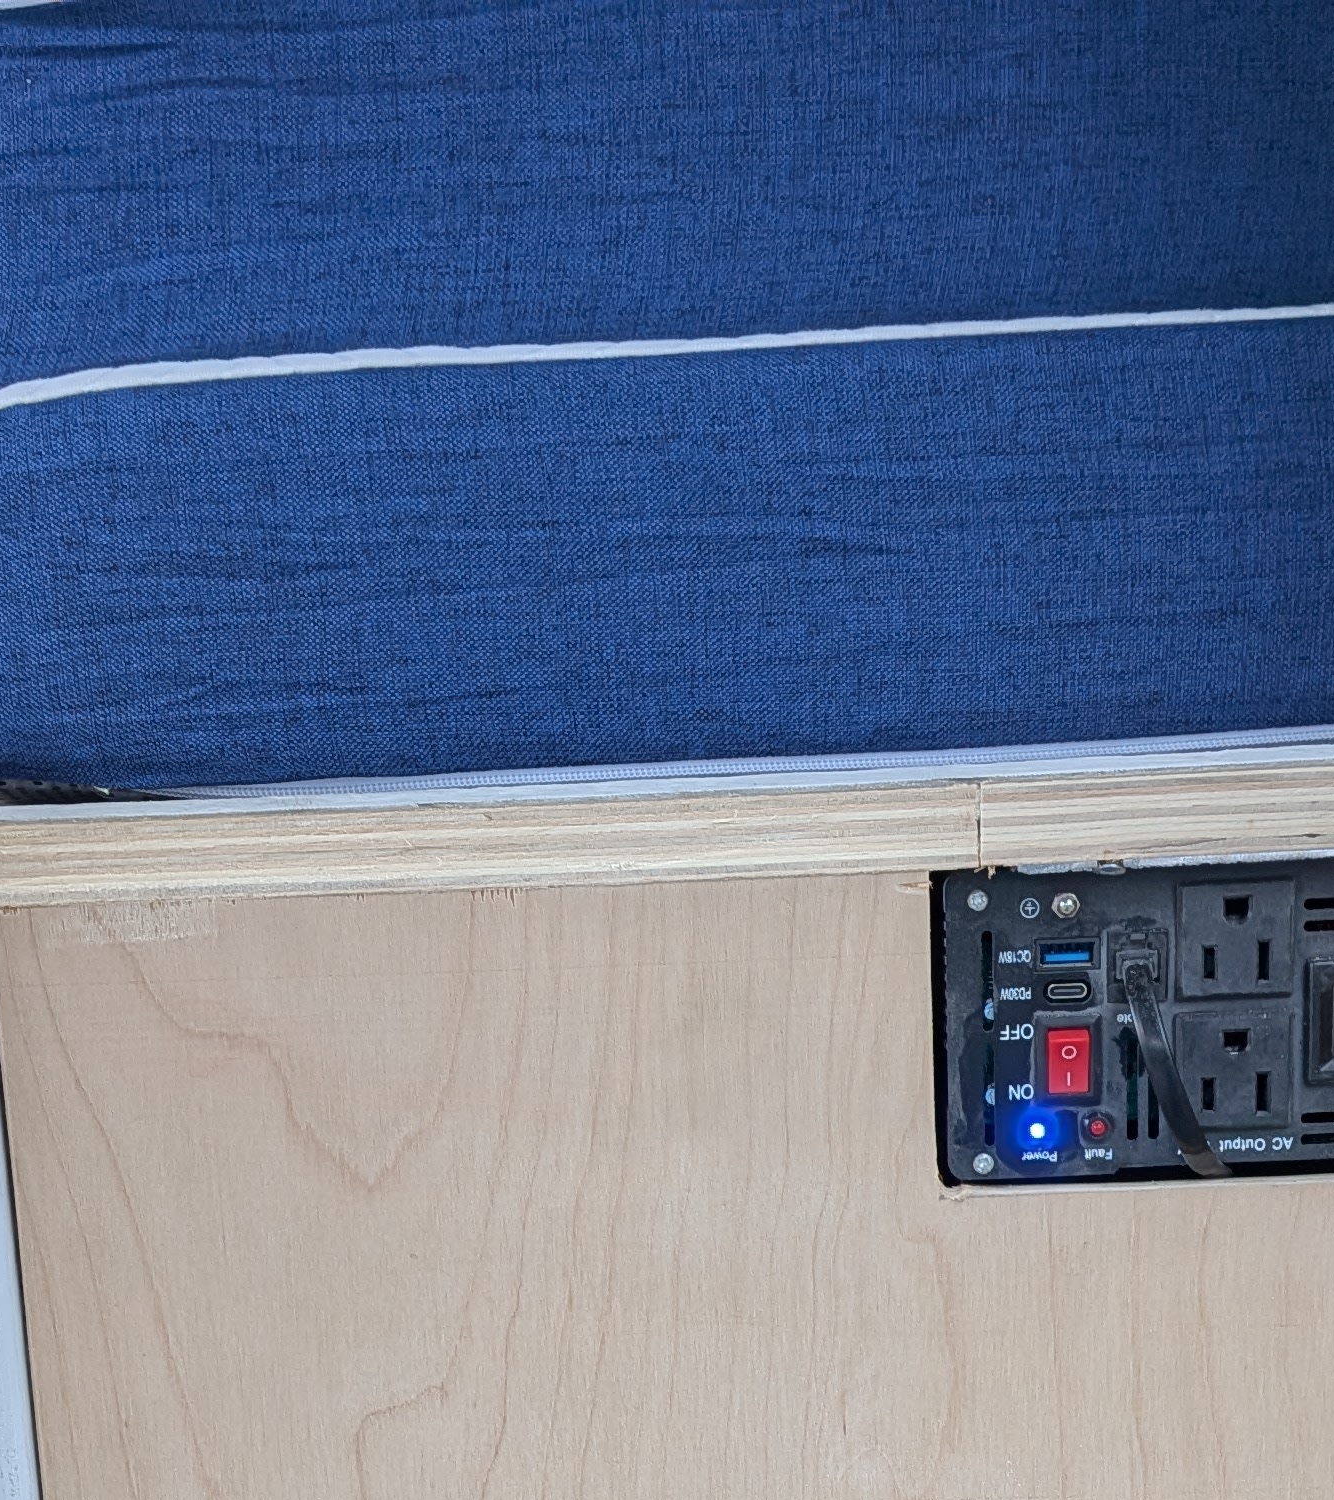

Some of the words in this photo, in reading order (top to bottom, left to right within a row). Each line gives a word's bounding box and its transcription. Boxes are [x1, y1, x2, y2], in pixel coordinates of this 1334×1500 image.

[1000, 987, 1032, 1001] PD30W
[999, 1023, 1035, 1041] OFF
[1008, 1083, 1035, 1101] ON
[1218, 1136, 1266, 1153] Output
[1271, 1136, 1294, 1151] AC
[1021, 1150, 1058, 1163] Power
[1084, 1148, 1113, 1160] Fault
